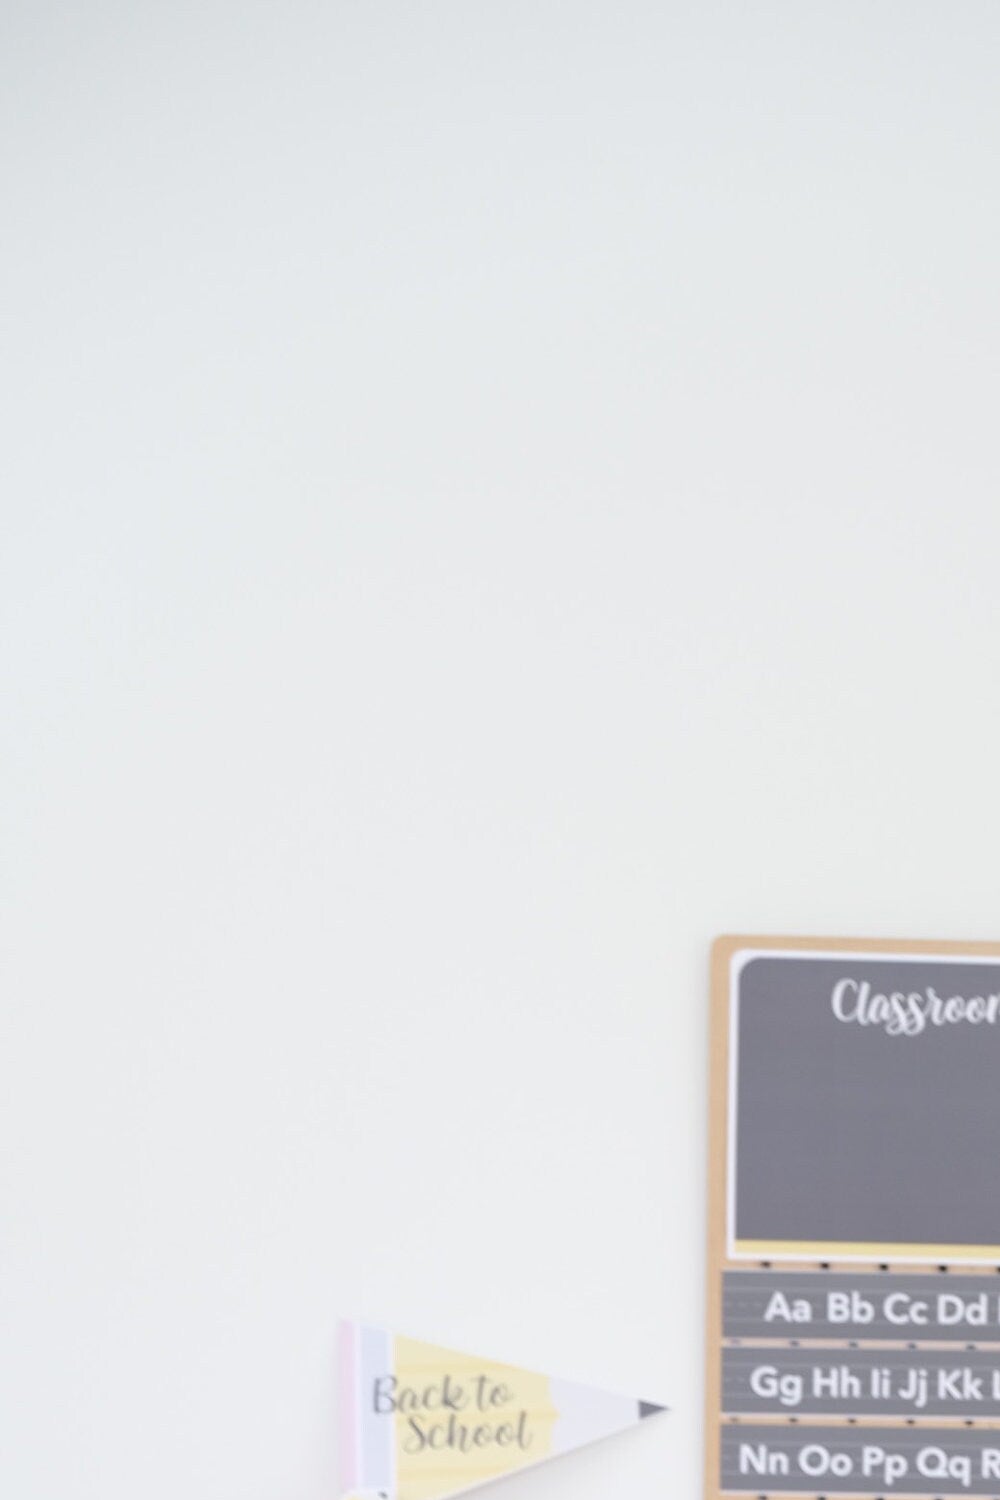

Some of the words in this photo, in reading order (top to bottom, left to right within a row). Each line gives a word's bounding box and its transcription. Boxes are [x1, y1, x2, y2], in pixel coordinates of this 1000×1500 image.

[765, 1292, 811, 1322] Aa
[827, 1291, 874, 1324] Bb
[884, 1293, 927, 1324] Cc
[937, 1294, 987, 1325] Dd
[373, 1374, 466, 1414] Back
[472, 1375, 514, 1409] to
[751, 1366, 802, 1405] Gg
[812, 1367, 861, 1400] Hh
[871, 1368, 891, 1400] Ii
[898, 1368, 928, 1408] Jj
[938, 1369, 984, 1401] Kk
[404, 1411, 533, 1453] School
[739, 1444, 789, 1476] Nn
[799, 1445, 852, 1476] Oo
[863, 1446, 907, 1484] Pp
[917, 1447, 970, 1486] Qq
